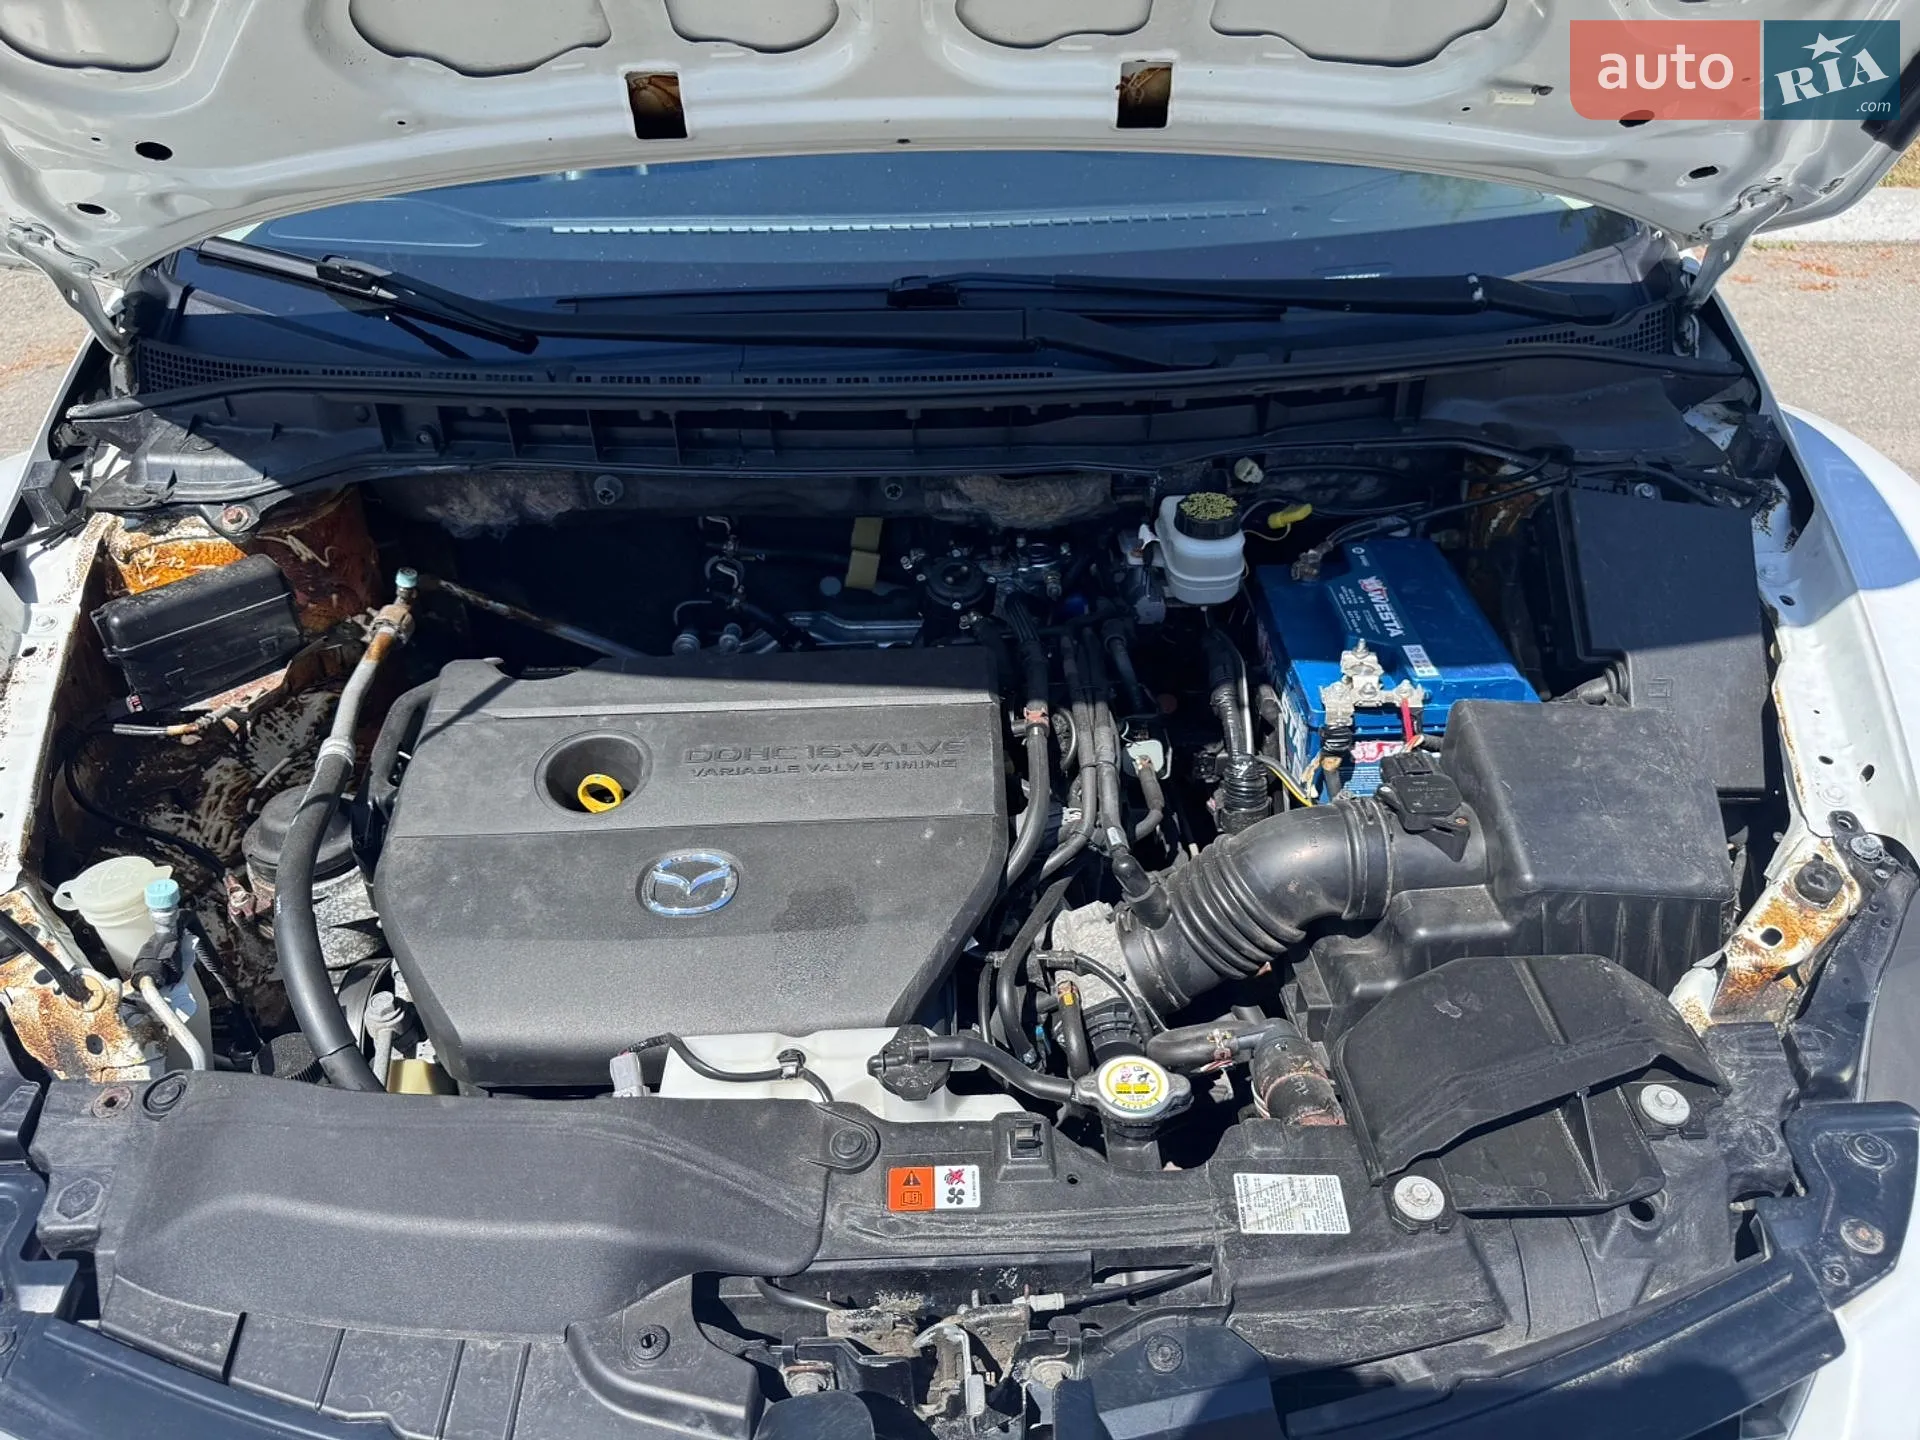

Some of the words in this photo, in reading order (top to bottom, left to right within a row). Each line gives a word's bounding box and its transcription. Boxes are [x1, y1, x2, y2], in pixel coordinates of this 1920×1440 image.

[1367, 586, 1405, 638] WESTA
[687, 745, 796, 763] DOHC
[807, 741, 966, 759] 16-VALVE
[692, 764, 801, 777] VARIABLE
[807, 762, 875, 773] VALVE
[882, 759, 957, 770] TIMING
